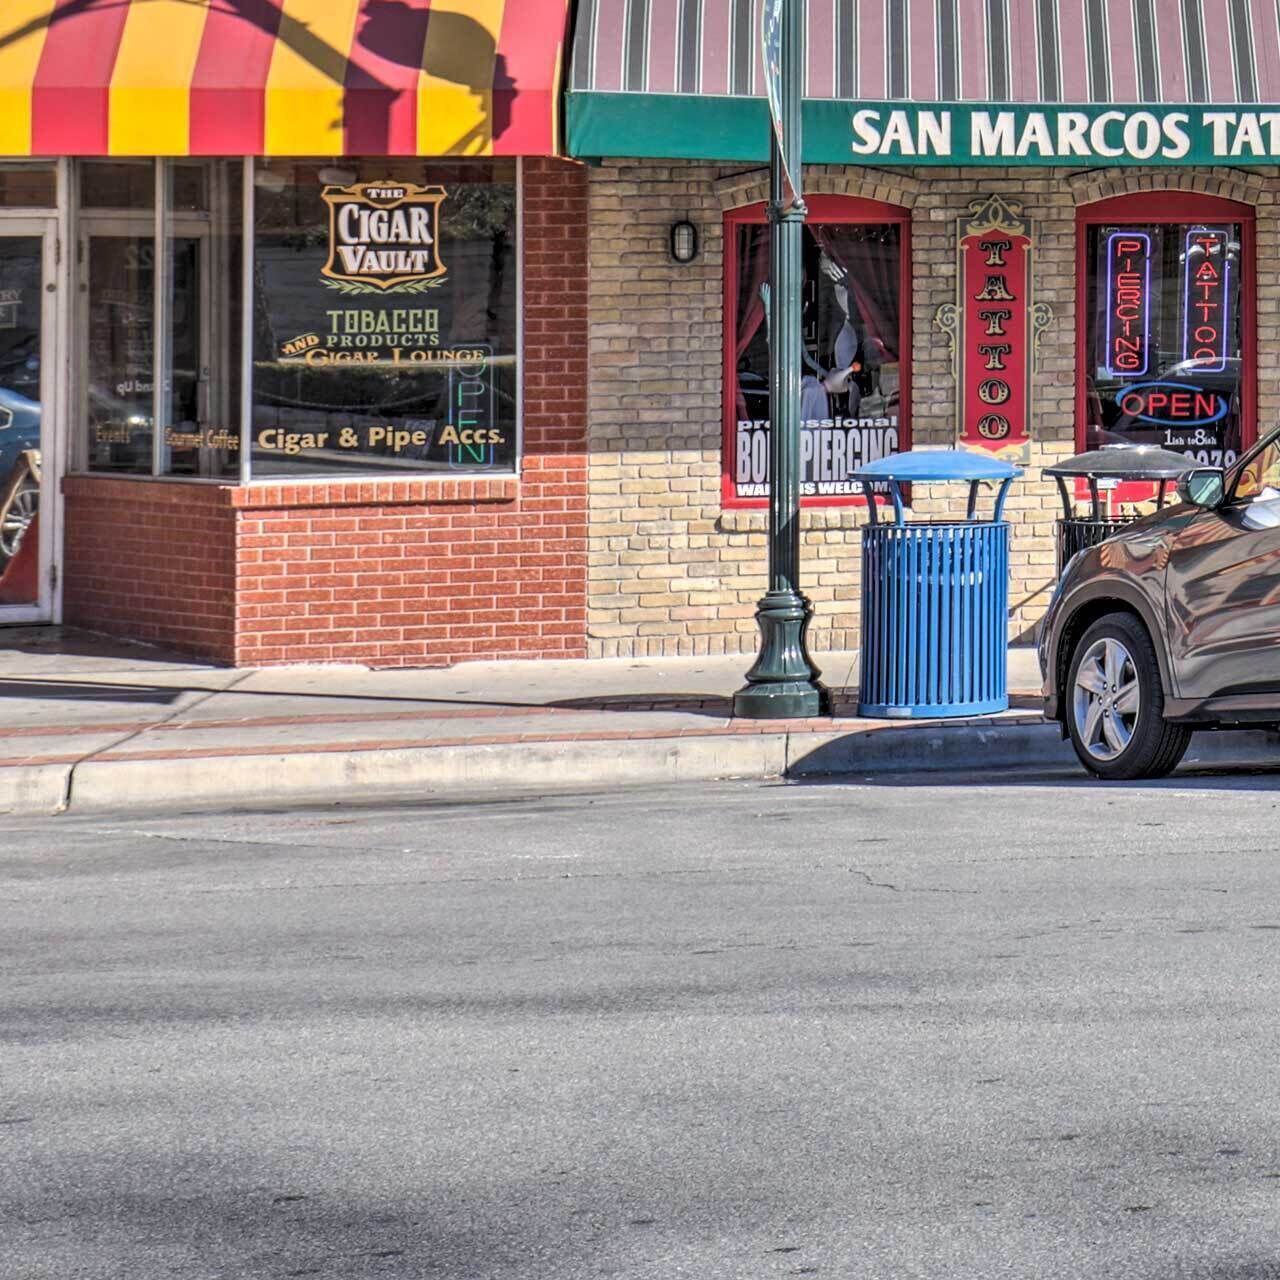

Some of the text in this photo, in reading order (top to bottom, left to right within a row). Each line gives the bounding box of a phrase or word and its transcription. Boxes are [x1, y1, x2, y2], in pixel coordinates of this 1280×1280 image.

[851, 109, 952, 157] SAN
[970, 110, 1191, 160] MARCOS
[366, 188, 404, 199] THE
[338, 203, 434, 245] CIGAR
[336, 245, 429, 274] VAULT
[1115, 240, 1142, 370] PIERCING
[1193, 238, 1219, 365] TATTOO
[326, 308, 440, 334] TOBACCO
[280, 333, 320, 355] AND
[326, 334, 440, 347] PRODUCTS
[974, 239, 1016, 441] TATTOO
[305, 348, 381, 367] CIGAR
[1121, 393, 1217, 417] OPEN
[737, 415, 898, 432] prssional
[206, 428, 240, 451] Coffee
[257, 424, 506, 455] Cigar & Pipe Accs.
